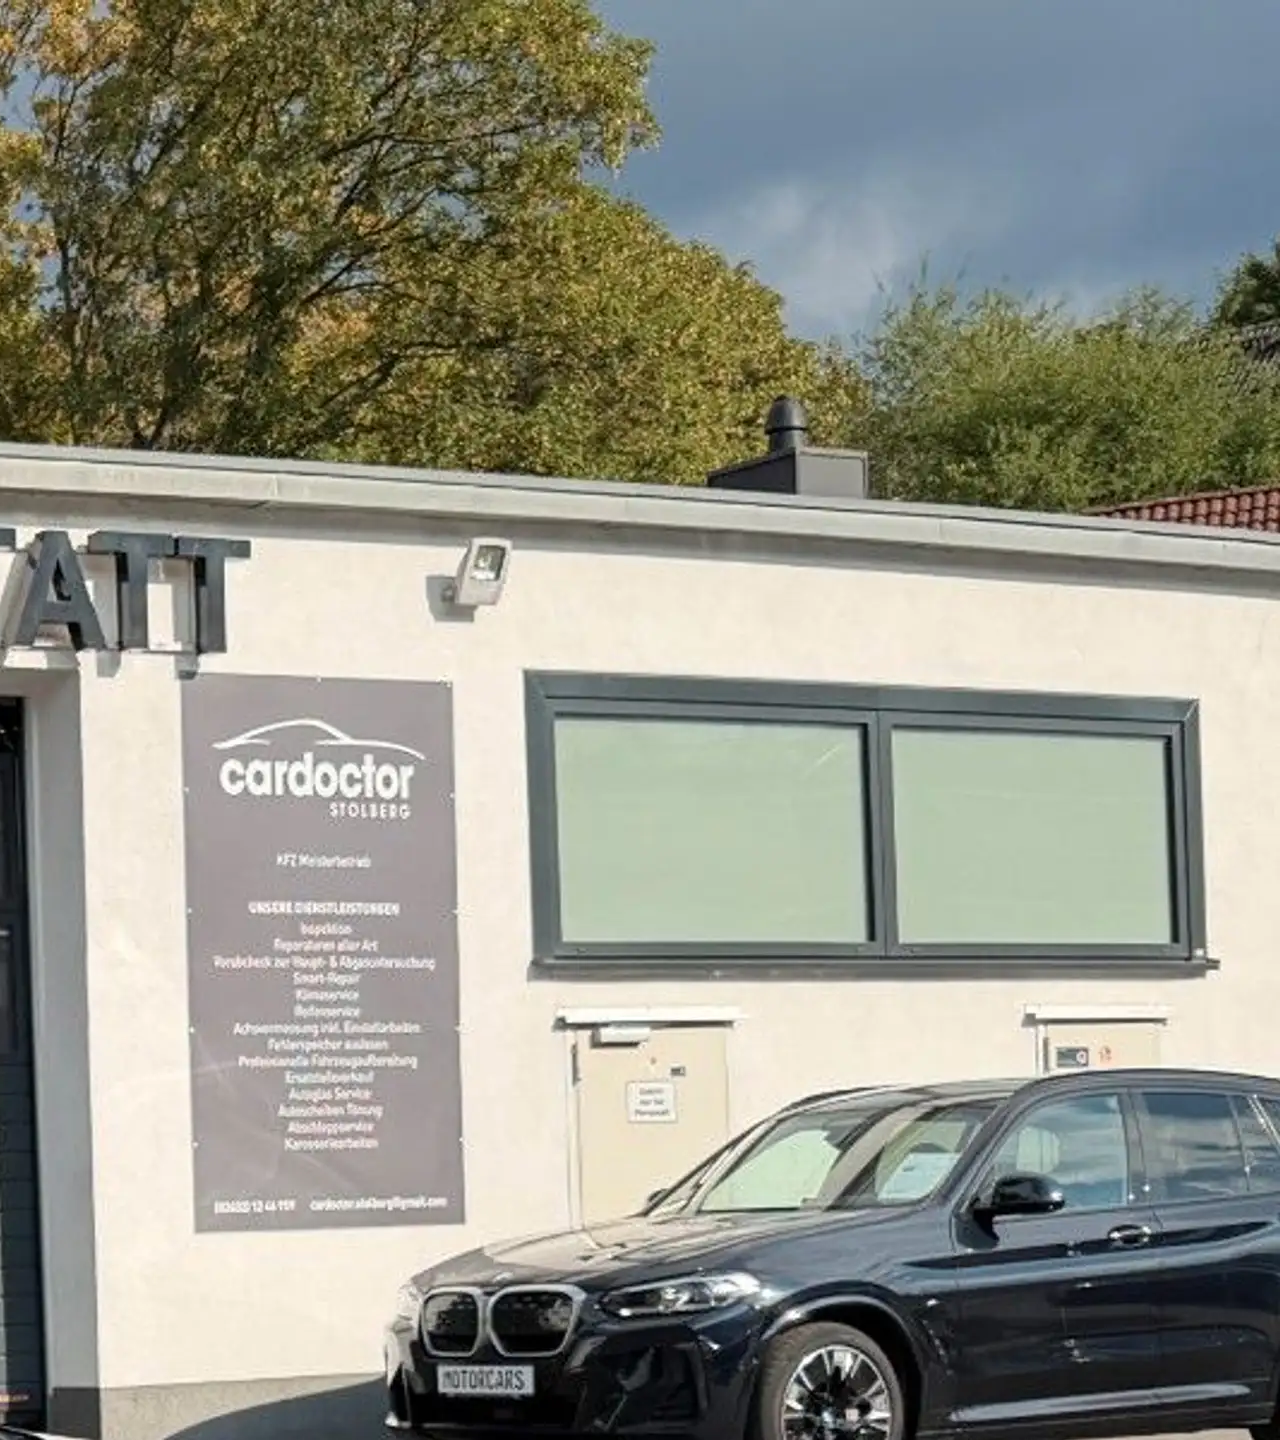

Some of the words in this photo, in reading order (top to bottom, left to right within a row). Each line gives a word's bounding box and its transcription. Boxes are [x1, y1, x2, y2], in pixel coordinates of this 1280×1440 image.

[219, 752, 415, 799] cardoctor
[329, 802, 411, 820] STOLBERG
[443, 1369, 525, 1391] MOTORCARS
